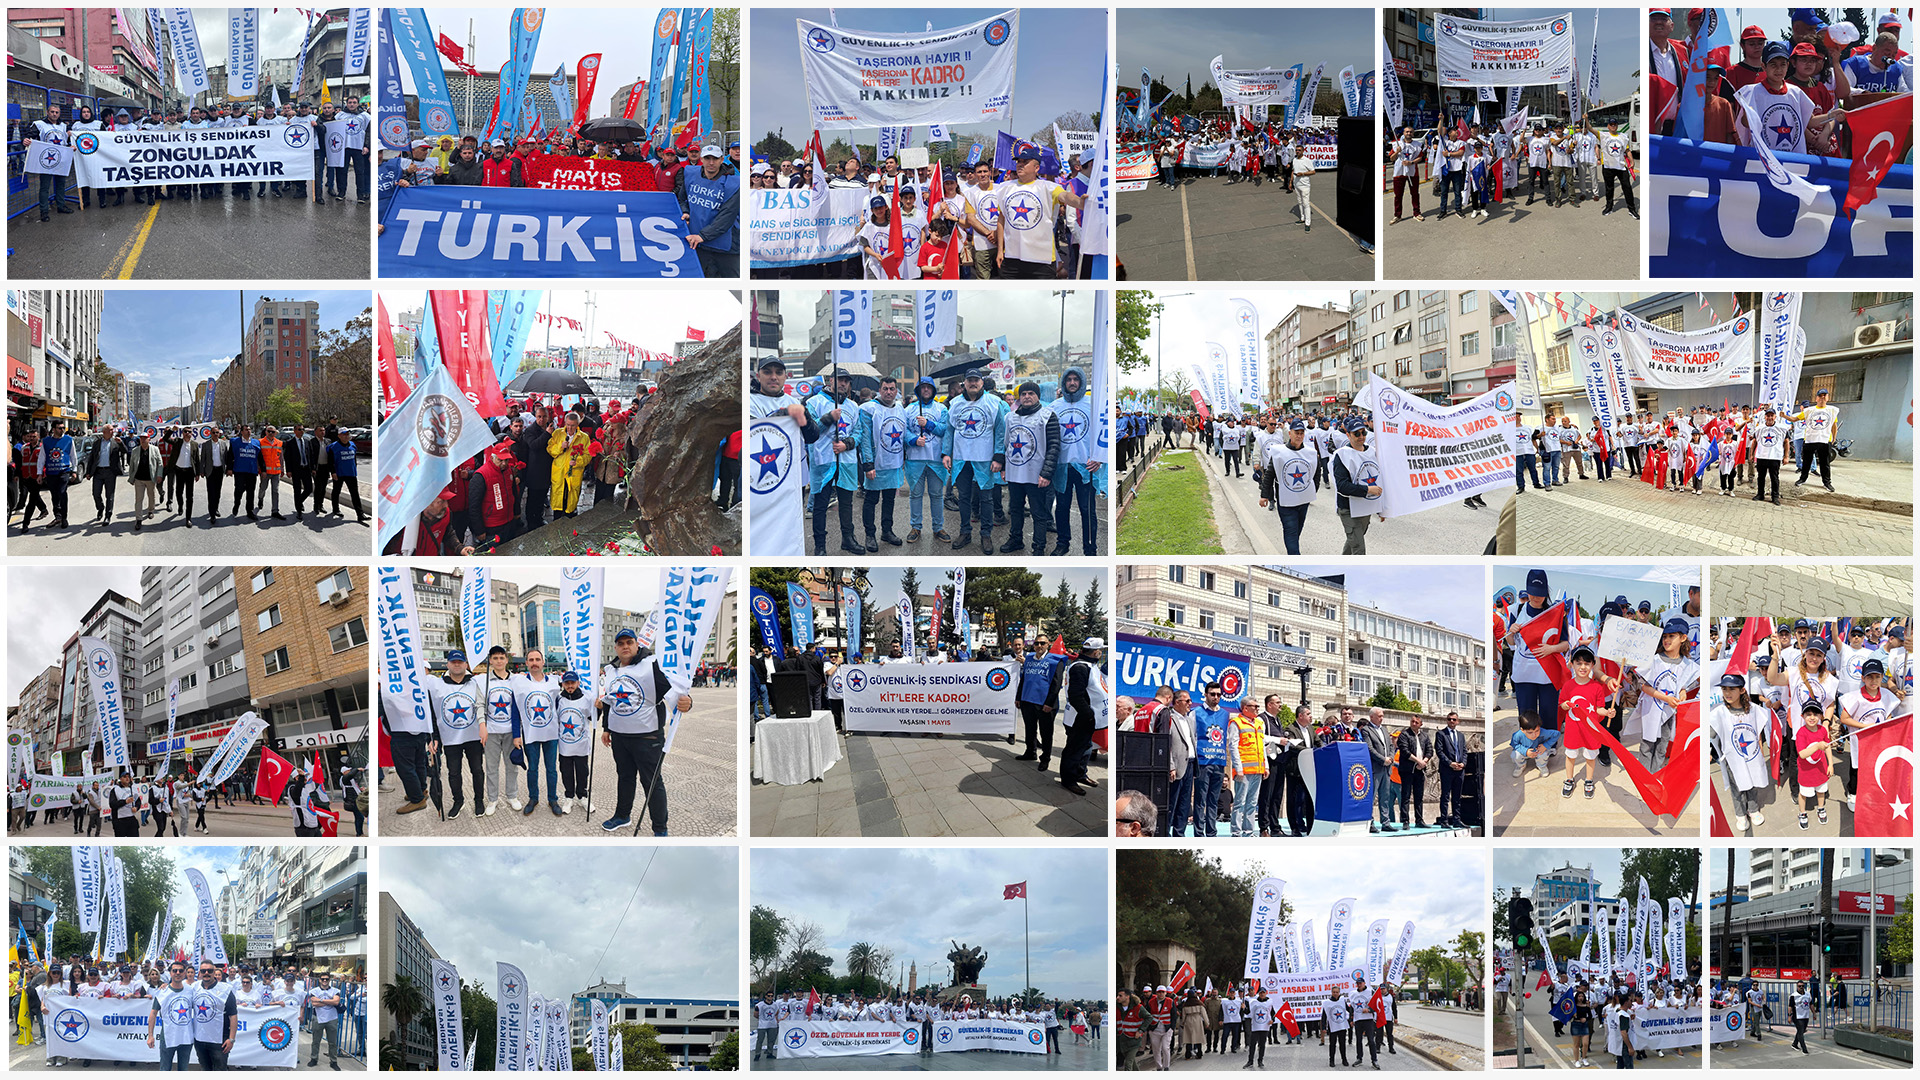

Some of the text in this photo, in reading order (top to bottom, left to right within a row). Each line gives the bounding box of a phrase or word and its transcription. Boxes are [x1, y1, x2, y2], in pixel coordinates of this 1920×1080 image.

[1514, 40, 1537, 48] HAYIR
[856, 56, 921, 68] TAŞERONA
[926, 52, 960, 64] HAYIR
[1504, 48, 1540, 60] KADRO
[1471, 62, 1530, 70] HAKKIMIZ
[860, 69, 908, 80] TAŞERONA
[911, 64, 966, 86] KADRO
[859, 88, 950, 101] HAKKIMIZ
[114, 129, 271, 144] GÜVENLİK İŞ SENDİKASI
[129, 145, 257, 163] ZONGULDAK
[103, 161, 285, 184] TAŞERONA HAYIR
[554, 168, 622, 187] MAYIS
[762, 190, 811, 210] BAS
[779, 216, 836, 228] ve SİGORTA
[396, 200, 685, 277] TÜRK-İŞ
[762, 230, 818, 242] SENDİKASI
[1694, 343, 1718, 352] HAYIR
[1684, 352, 1720, 365] KADRO
[1648, 361, 1709, 374] HAKKIMIZ
[1405, 420, 1455, 440] YAŞASIN
[1462, 415, 1498, 436] MAYIS
[1405, 433, 1505, 456] VERGİDE ADALETSİZLİĞE
[1407, 443, 1512, 471] TAŞERONLAŞTIRMAYA
[1410, 472, 1440, 488] DUR
[1420, 470, 1516, 502] KADRO HAKKIMIZDIR
[870, 674, 982, 686] GÜVENLİK-İŞ SENDİKASI
[928, 693, 970, 703] KADRO!
[849, 706, 864, 714] ÖZEL
[866, 706, 896, 714] GÜVENLİK
[1250, 905, 1271, 974] GÜVENLİK-İŞ
[1263, 918, 1276, 960] SENDİKASI
[1281, 986, 1316, 995] YAŞASIN
[1642, 1016, 1684, 1028] GÜVENLİK-İŞ
[810, 1031, 830, 1039] ÖZEL
[832, 1030, 865, 1038] GÜVENLİK
[992, 1026, 1024, 1035] SENDİKASI
[1671, 1028, 1685, 1036] BÖLGE
